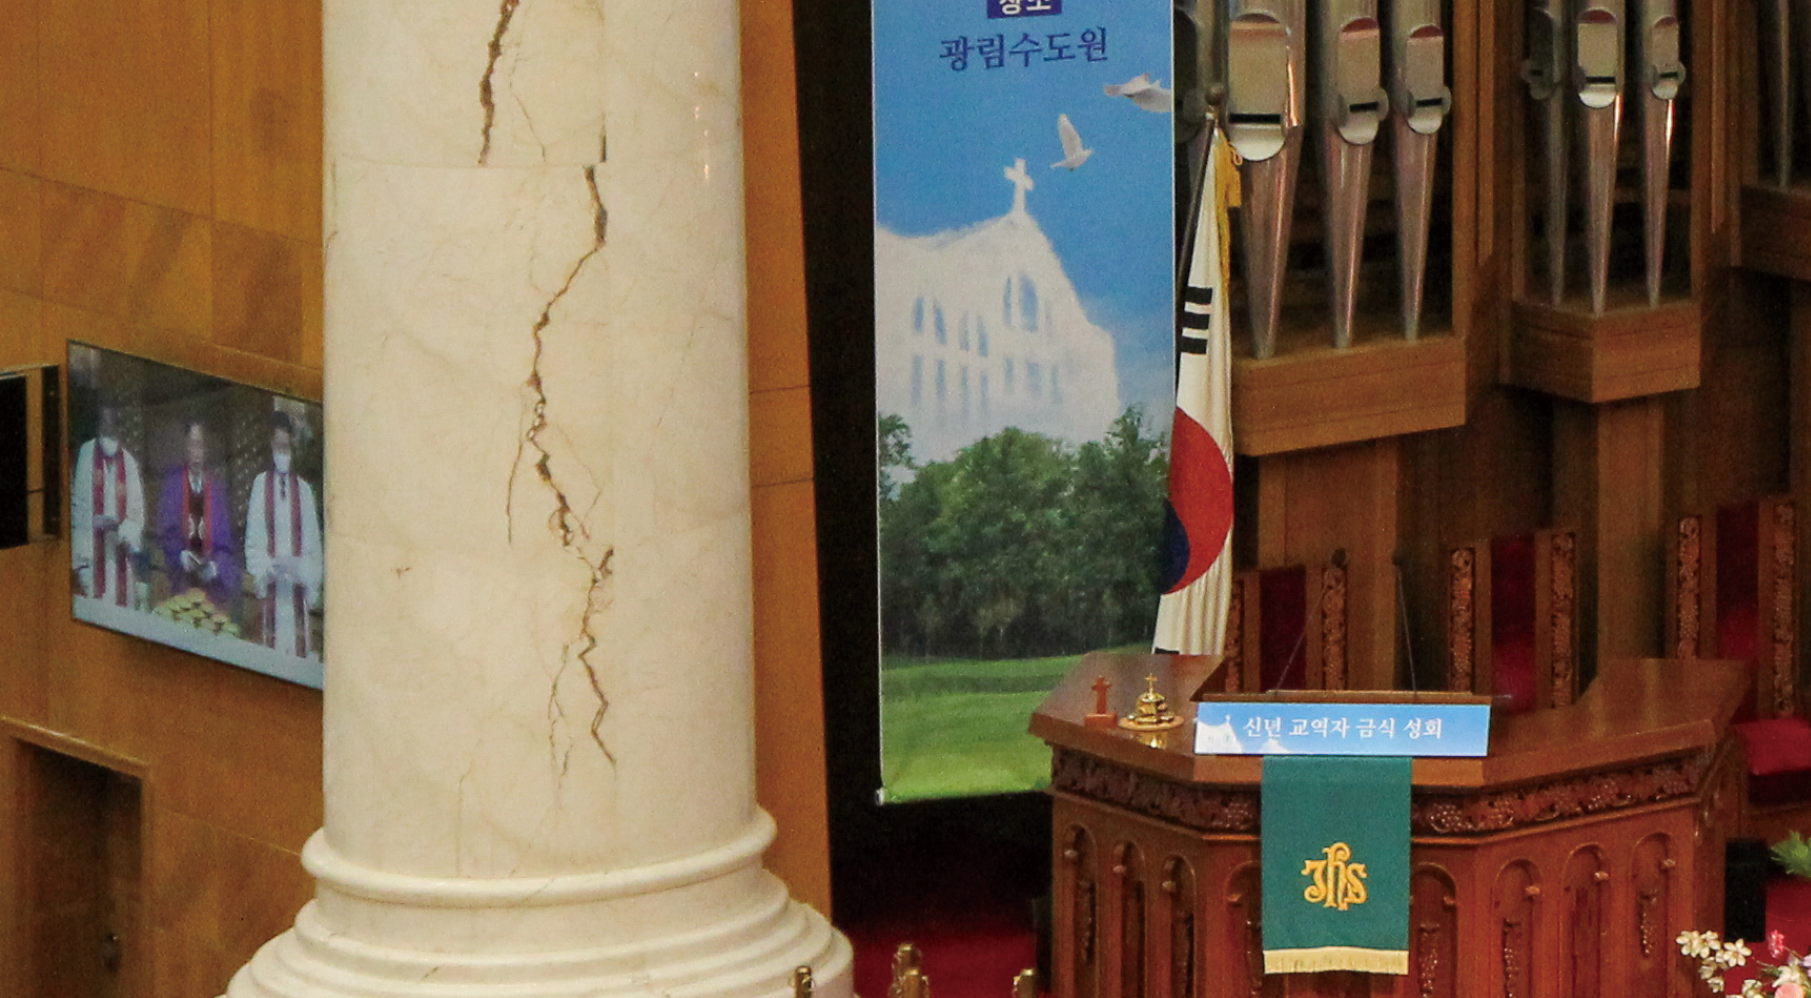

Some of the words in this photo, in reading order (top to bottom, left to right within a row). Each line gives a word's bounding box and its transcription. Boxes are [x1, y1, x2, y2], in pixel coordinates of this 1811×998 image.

[938, 25, 1109, 73] 광림수도원
[1242, 716, 1283, 739] 신년
[1288, 716, 1350, 739] 교역자
[1355, 717, 1396, 739] 금식
[1402, 717, 1443, 740] 성회
